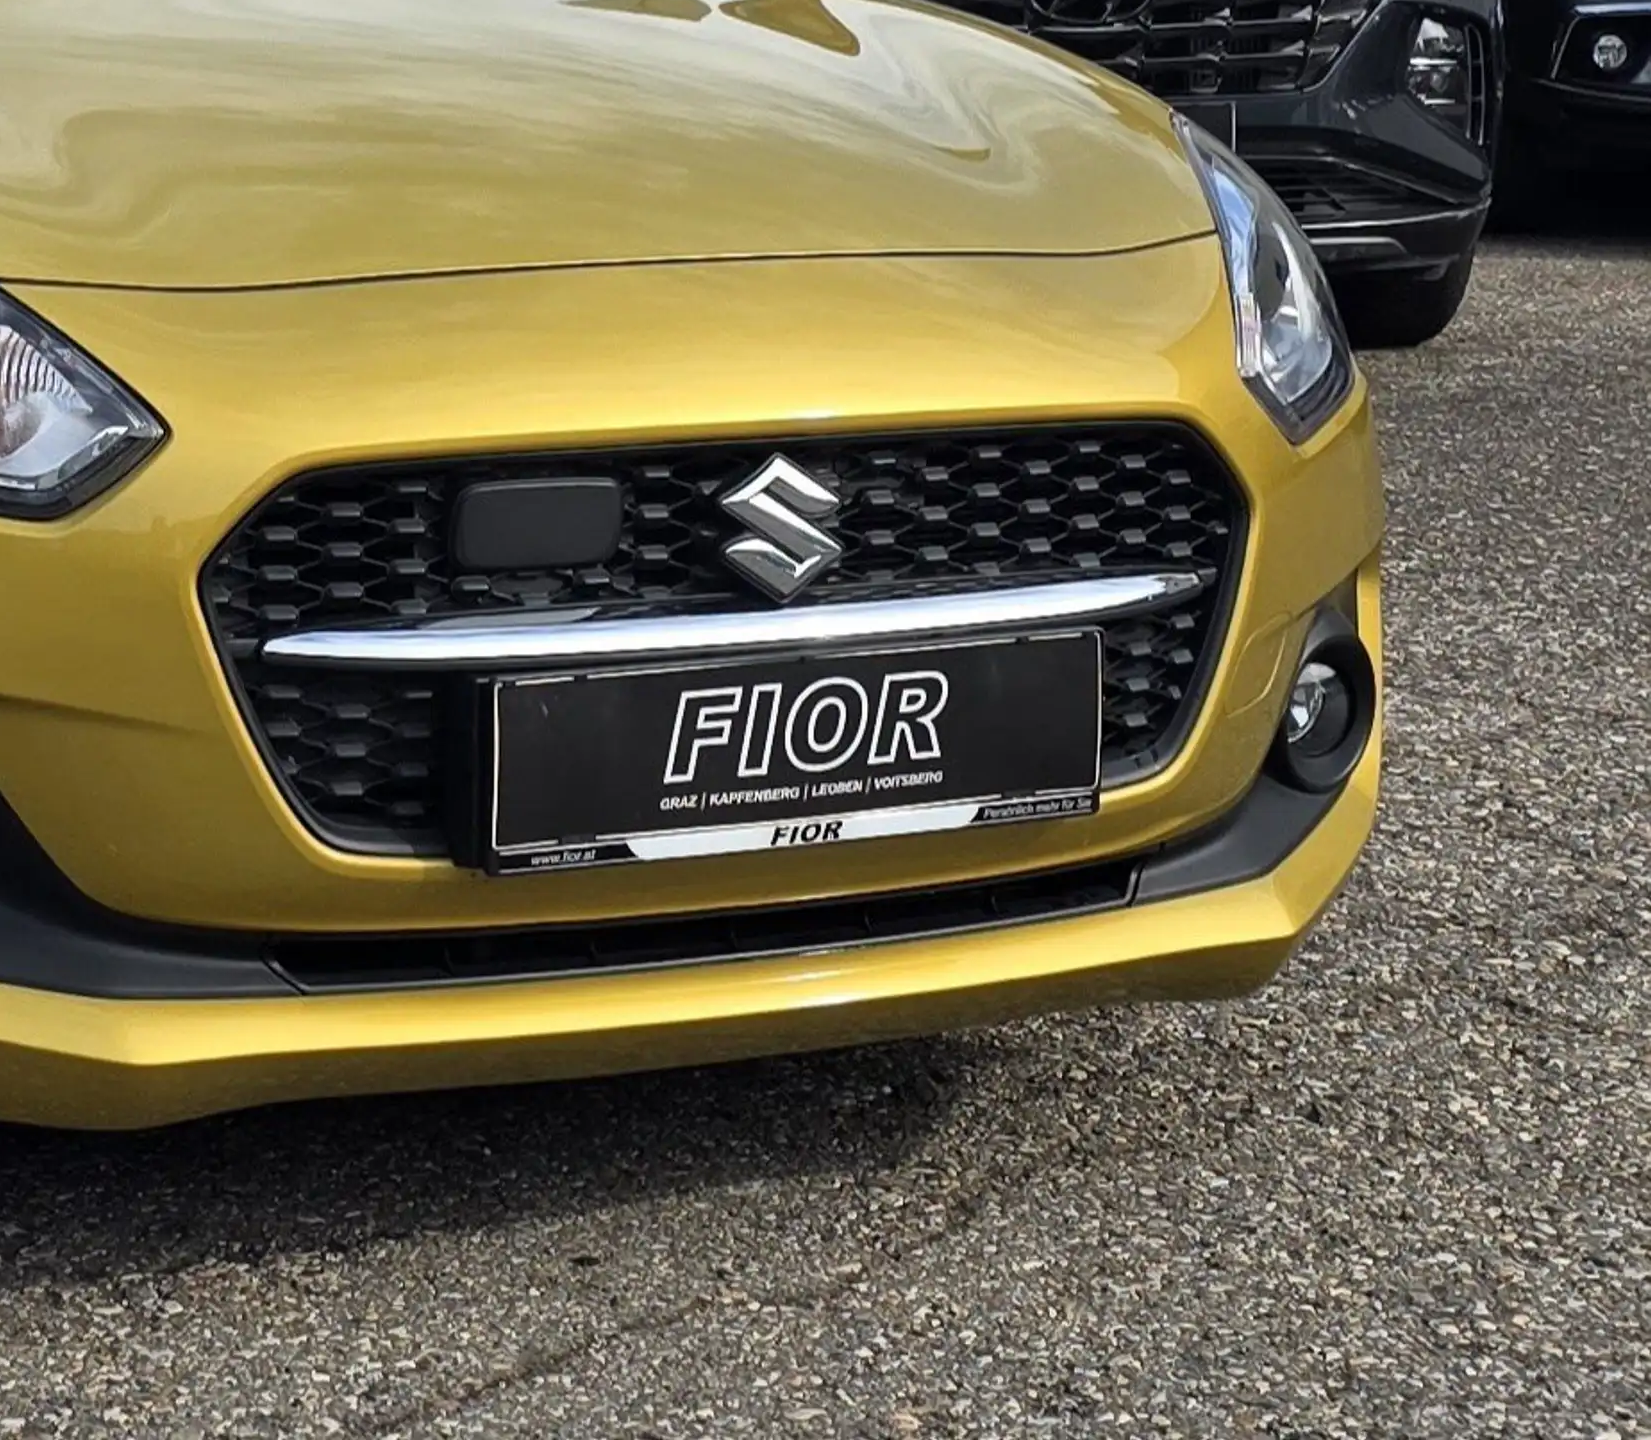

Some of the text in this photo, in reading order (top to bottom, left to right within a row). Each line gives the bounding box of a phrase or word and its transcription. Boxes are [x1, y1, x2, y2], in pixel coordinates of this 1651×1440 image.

[663, 670, 949, 784] FIOR
[660, 770, 943, 810] GRAZ KAPFENBERG LEOBEN VOITSBERG
[770, 820, 843, 846] FIOR
[531, 849, 597, 865] www.fior.at
